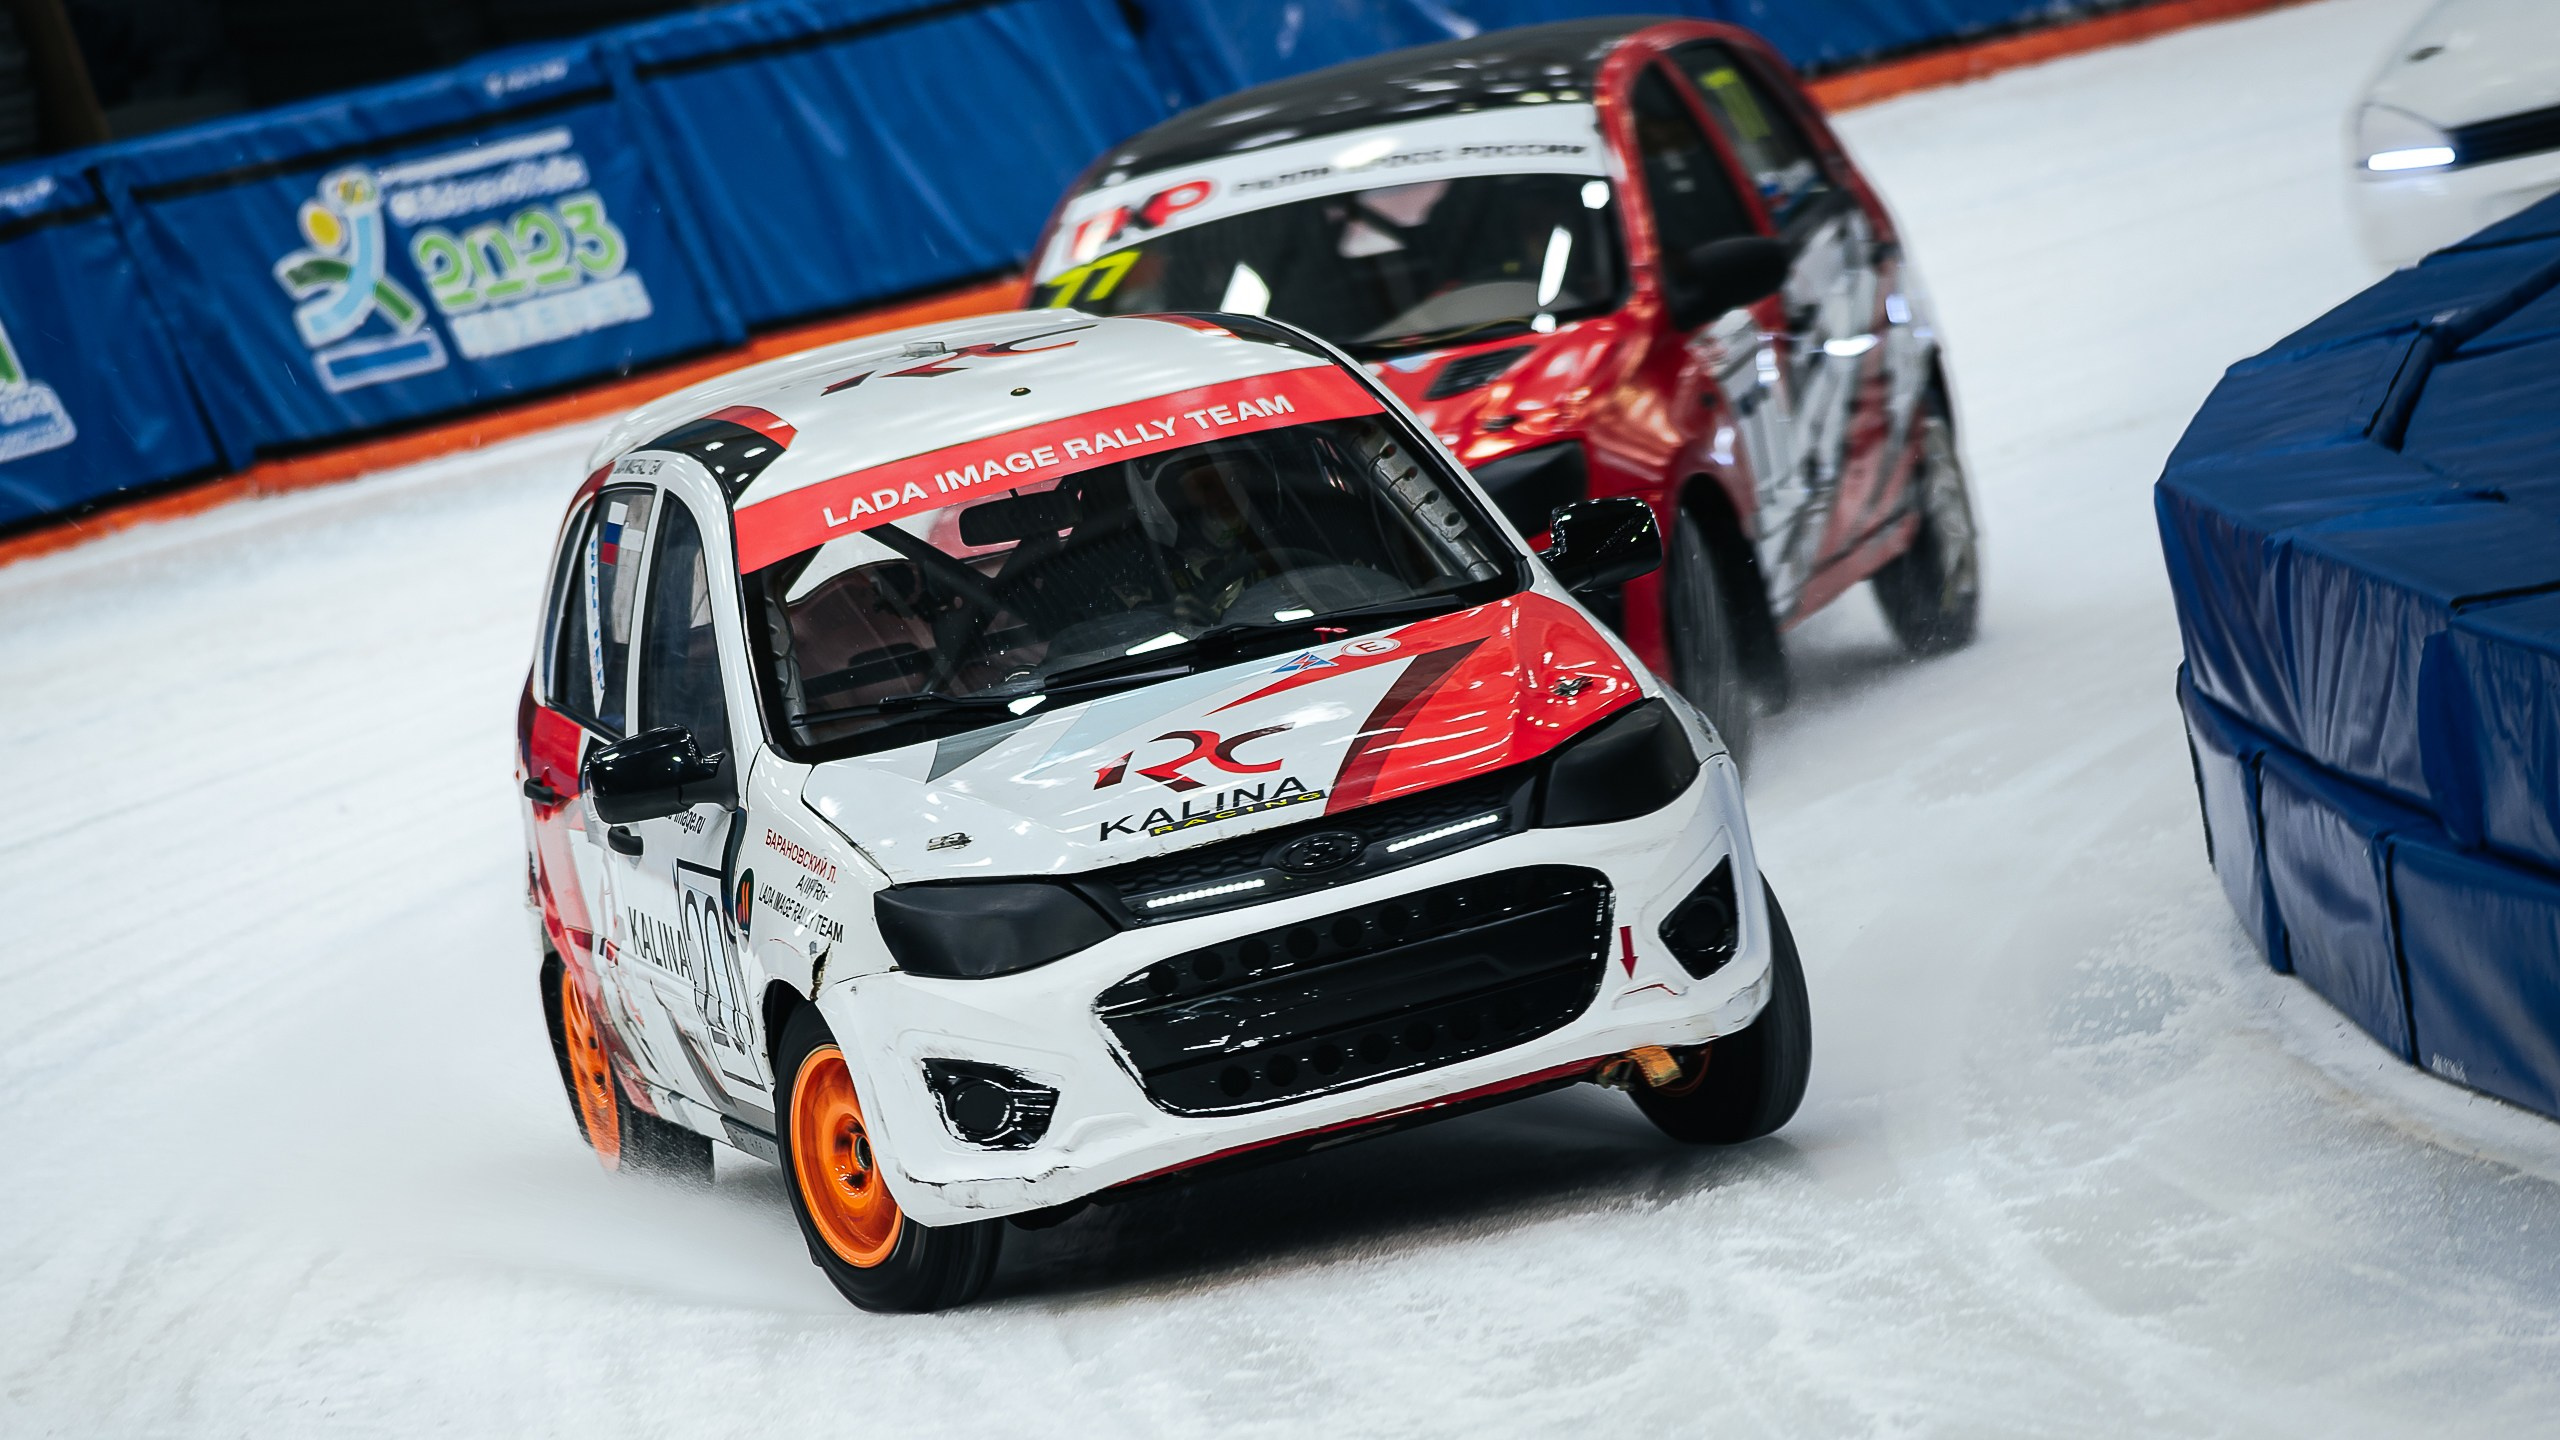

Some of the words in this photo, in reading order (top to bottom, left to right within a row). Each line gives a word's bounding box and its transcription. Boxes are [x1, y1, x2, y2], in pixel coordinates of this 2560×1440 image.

[1048, 251, 1141, 309] 77
[822, 481, 926, 528] LADA
[934, 444, 1061, 495] IMAGE
[1062, 415, 1177, 461] RALLY
[1183, 394, 1296, 431] TEAM
[1099, 776, 1308, 842] KALINA
[1152, 791, 1321, 835] RACING
[765, 828, 828, 878] БАРАНОВСКИЙ
[826, 864, 837, 884] Л.
[627, 906, 693, 982] KALINA
[758, 882, 776, 908] LADA
[772, 891, 796, 918] IMAGE
[790, 902, 818, 930] RALLY
[814, 913, 844, 944] TEAM
